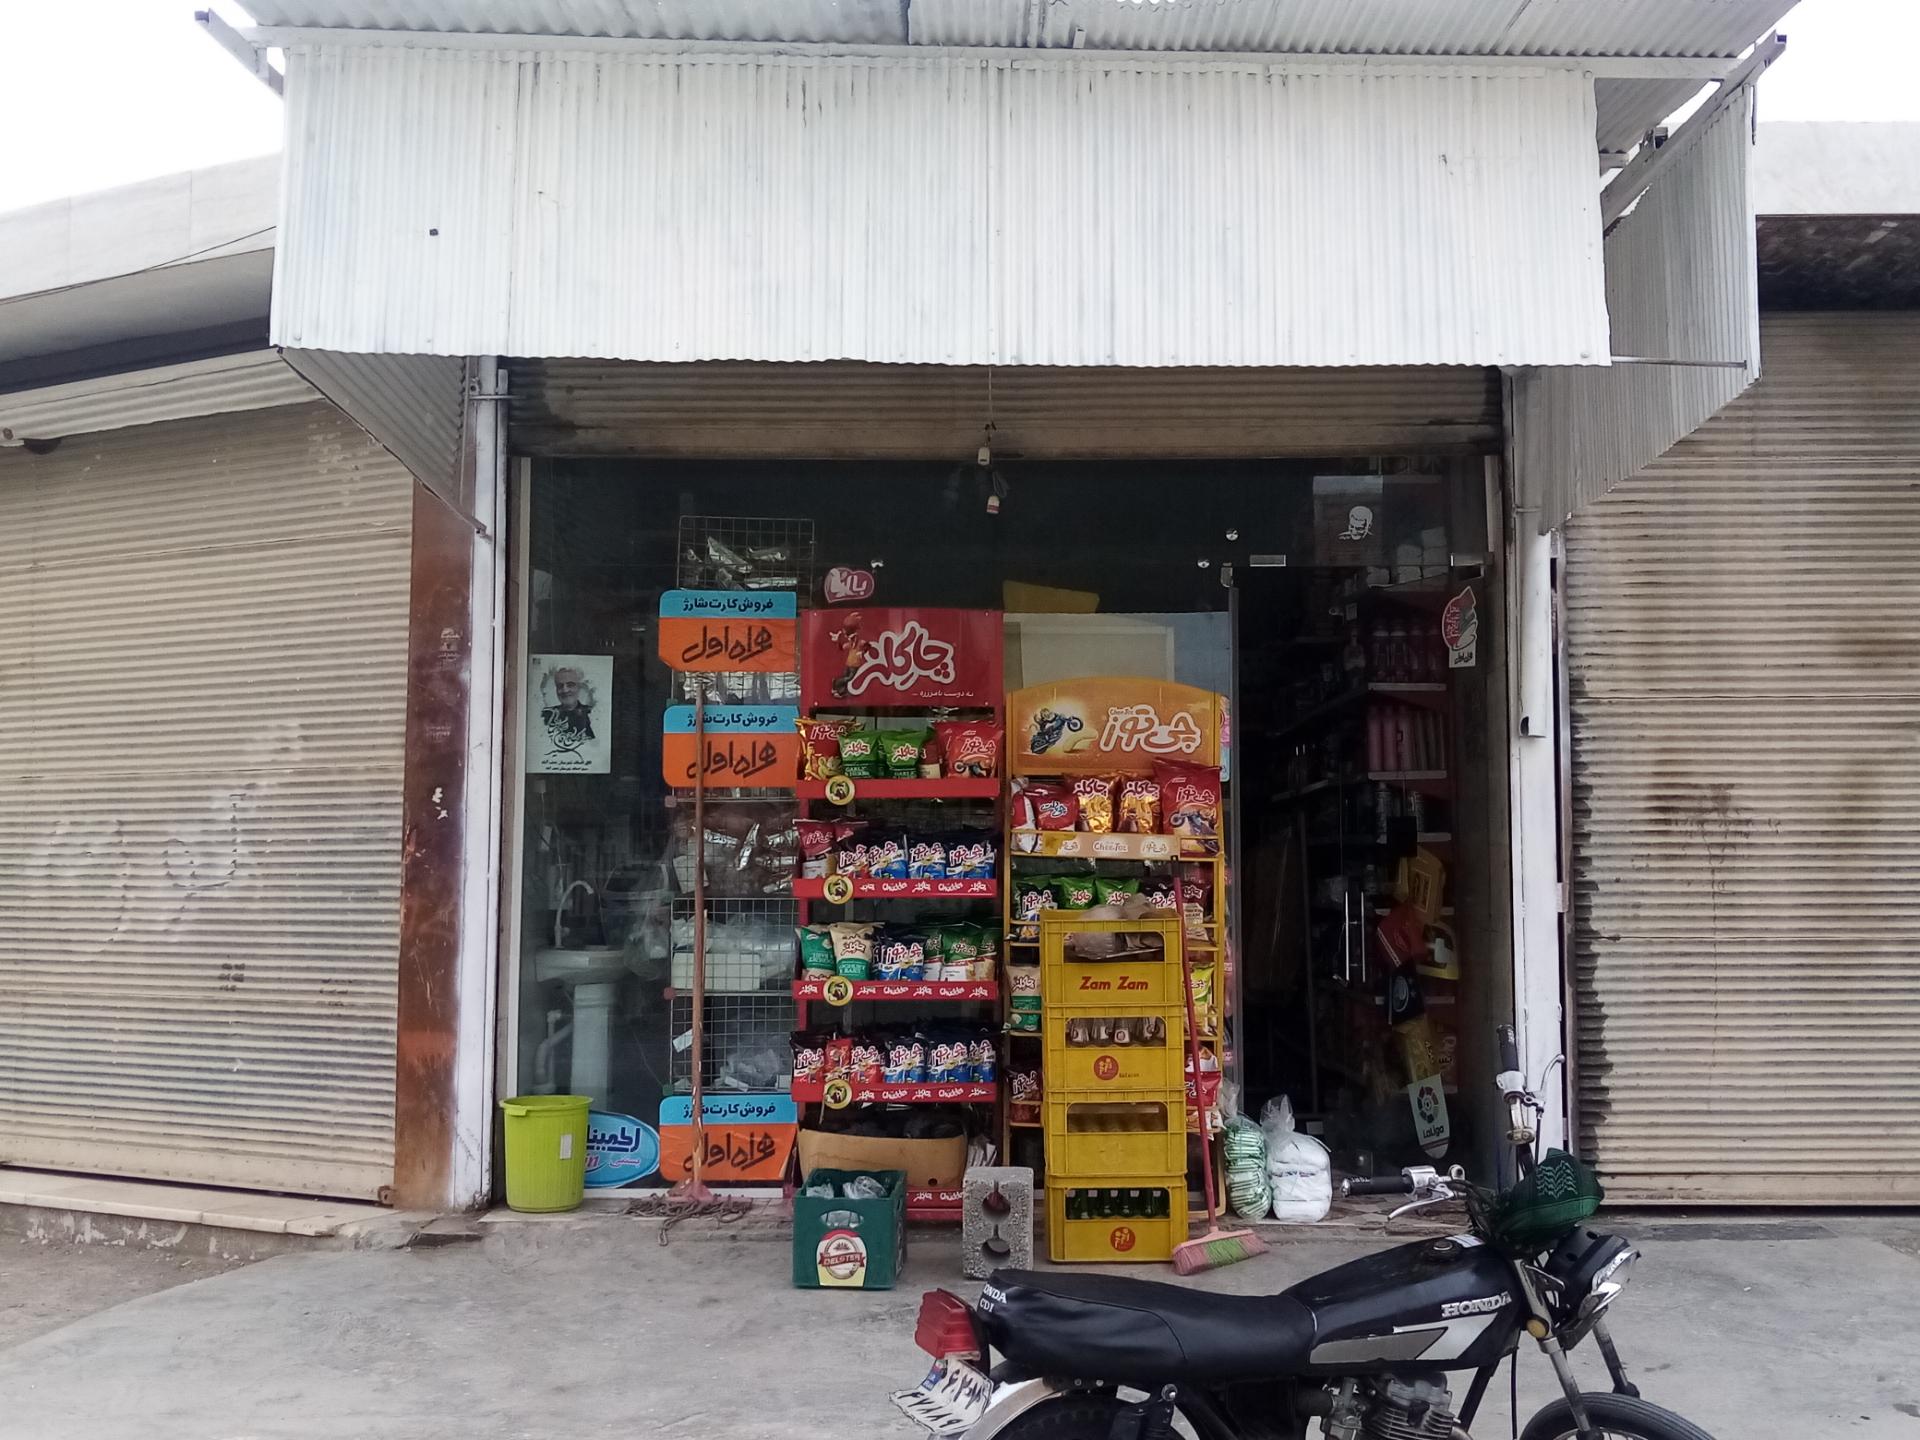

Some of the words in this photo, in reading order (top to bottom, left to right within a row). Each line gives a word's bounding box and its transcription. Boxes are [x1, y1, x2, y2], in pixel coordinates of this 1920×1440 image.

[683, 597, 710, 611] شارژ
[709, 598, 738, 612] کارت
[738, 598, 773, 612] فروش
[682, 625, 729, 663] اول
[728, 625, 773, 664] همراه
[713, 712, 742, 727] کارت
[742, 711, 778, 727] فروش
[733, 740, 777, 778] همراه
[1079, 976, 1111, 991] Zam
[1116, 976, 1149, 991] Zam
[710, 1103, 740, 1117] کارت
[740, 1101, 776, 1117] فروش
[731, 1131, 776, 1172] همراه
[823, 1254, 860, 1266] DELSTER
[980, 1297, 995, 1313] CDI
[1441, 1291, 1512, 1318] HONDA
